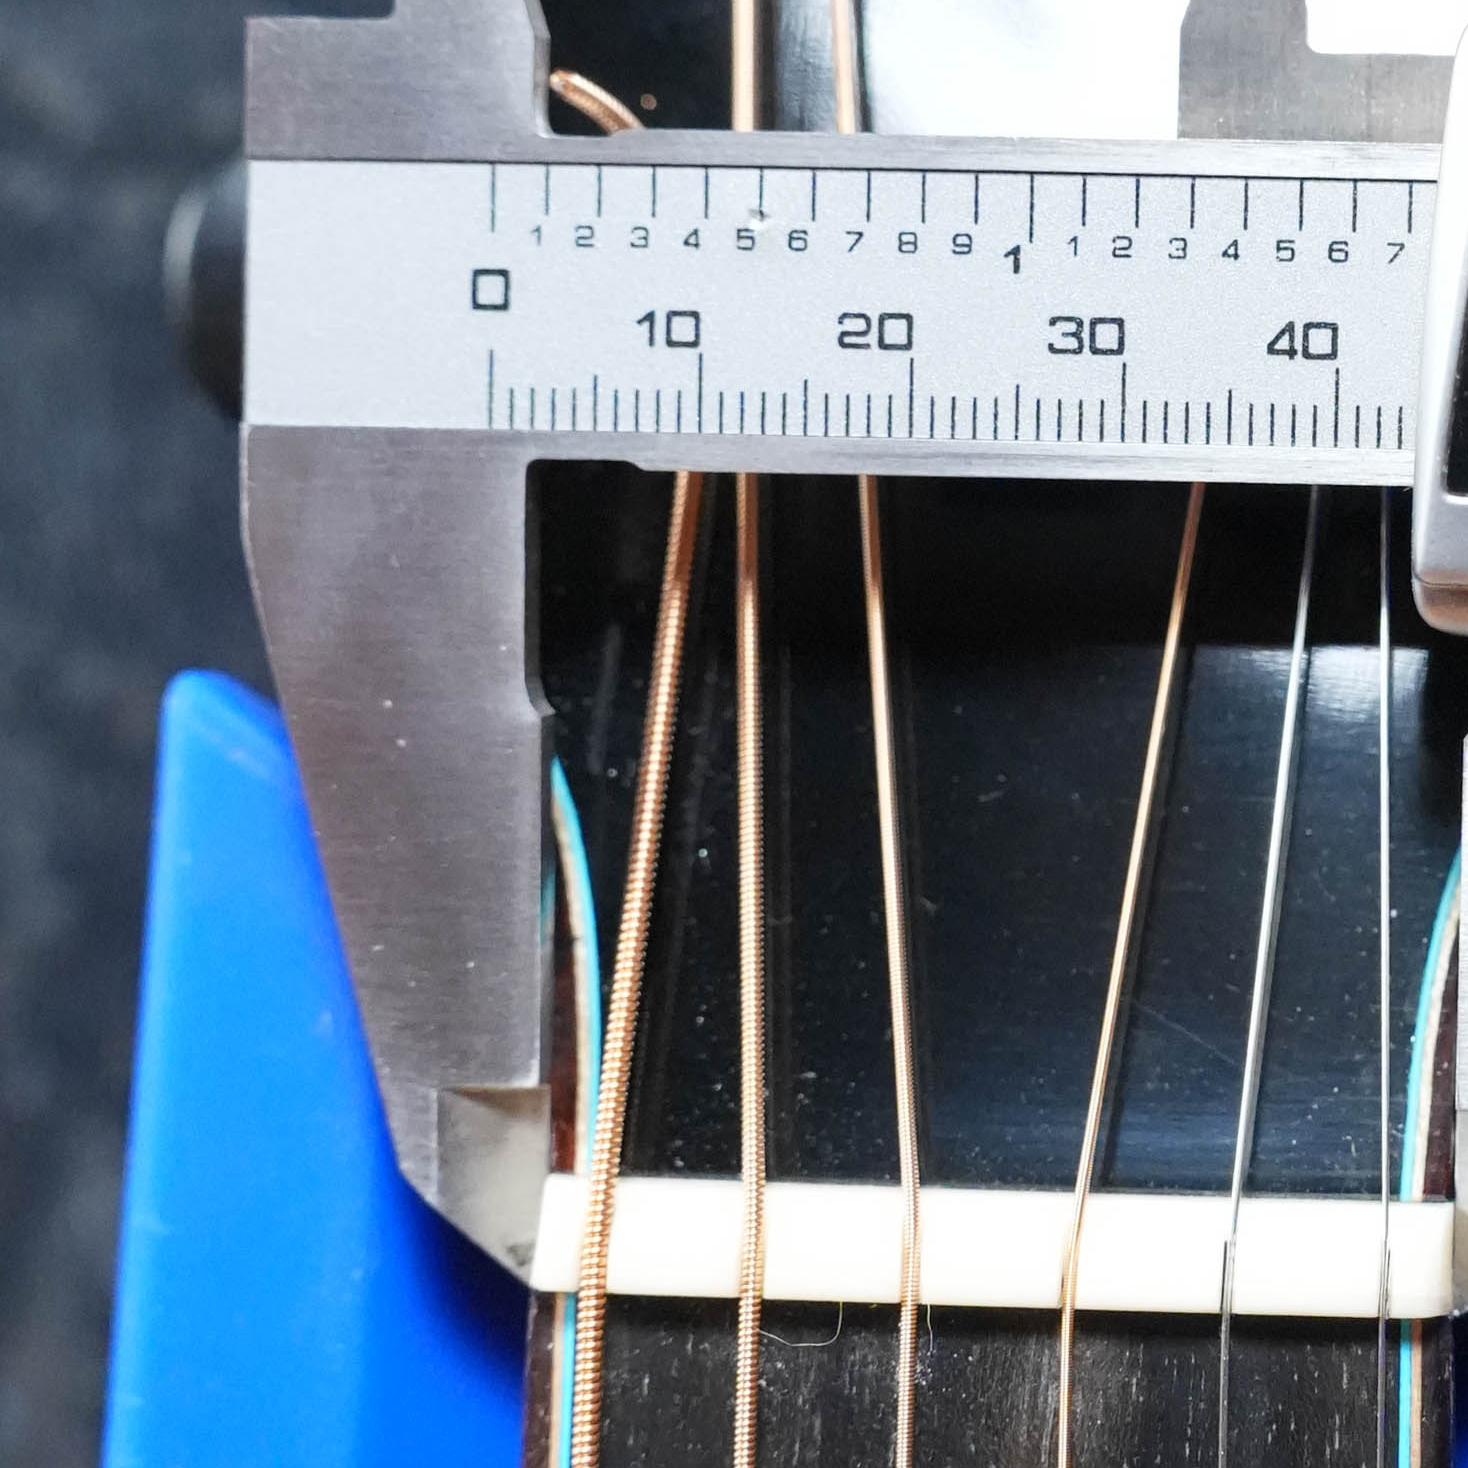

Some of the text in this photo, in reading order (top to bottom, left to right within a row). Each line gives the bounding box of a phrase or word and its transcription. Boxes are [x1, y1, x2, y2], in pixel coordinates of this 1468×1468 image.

[530, 225, 1405, 274] 1 2 3 4 5 6 7 8 9 1 1 2 3 4 5 6 7
[471, 269, 1339, 361] 0 10 20 30 40
